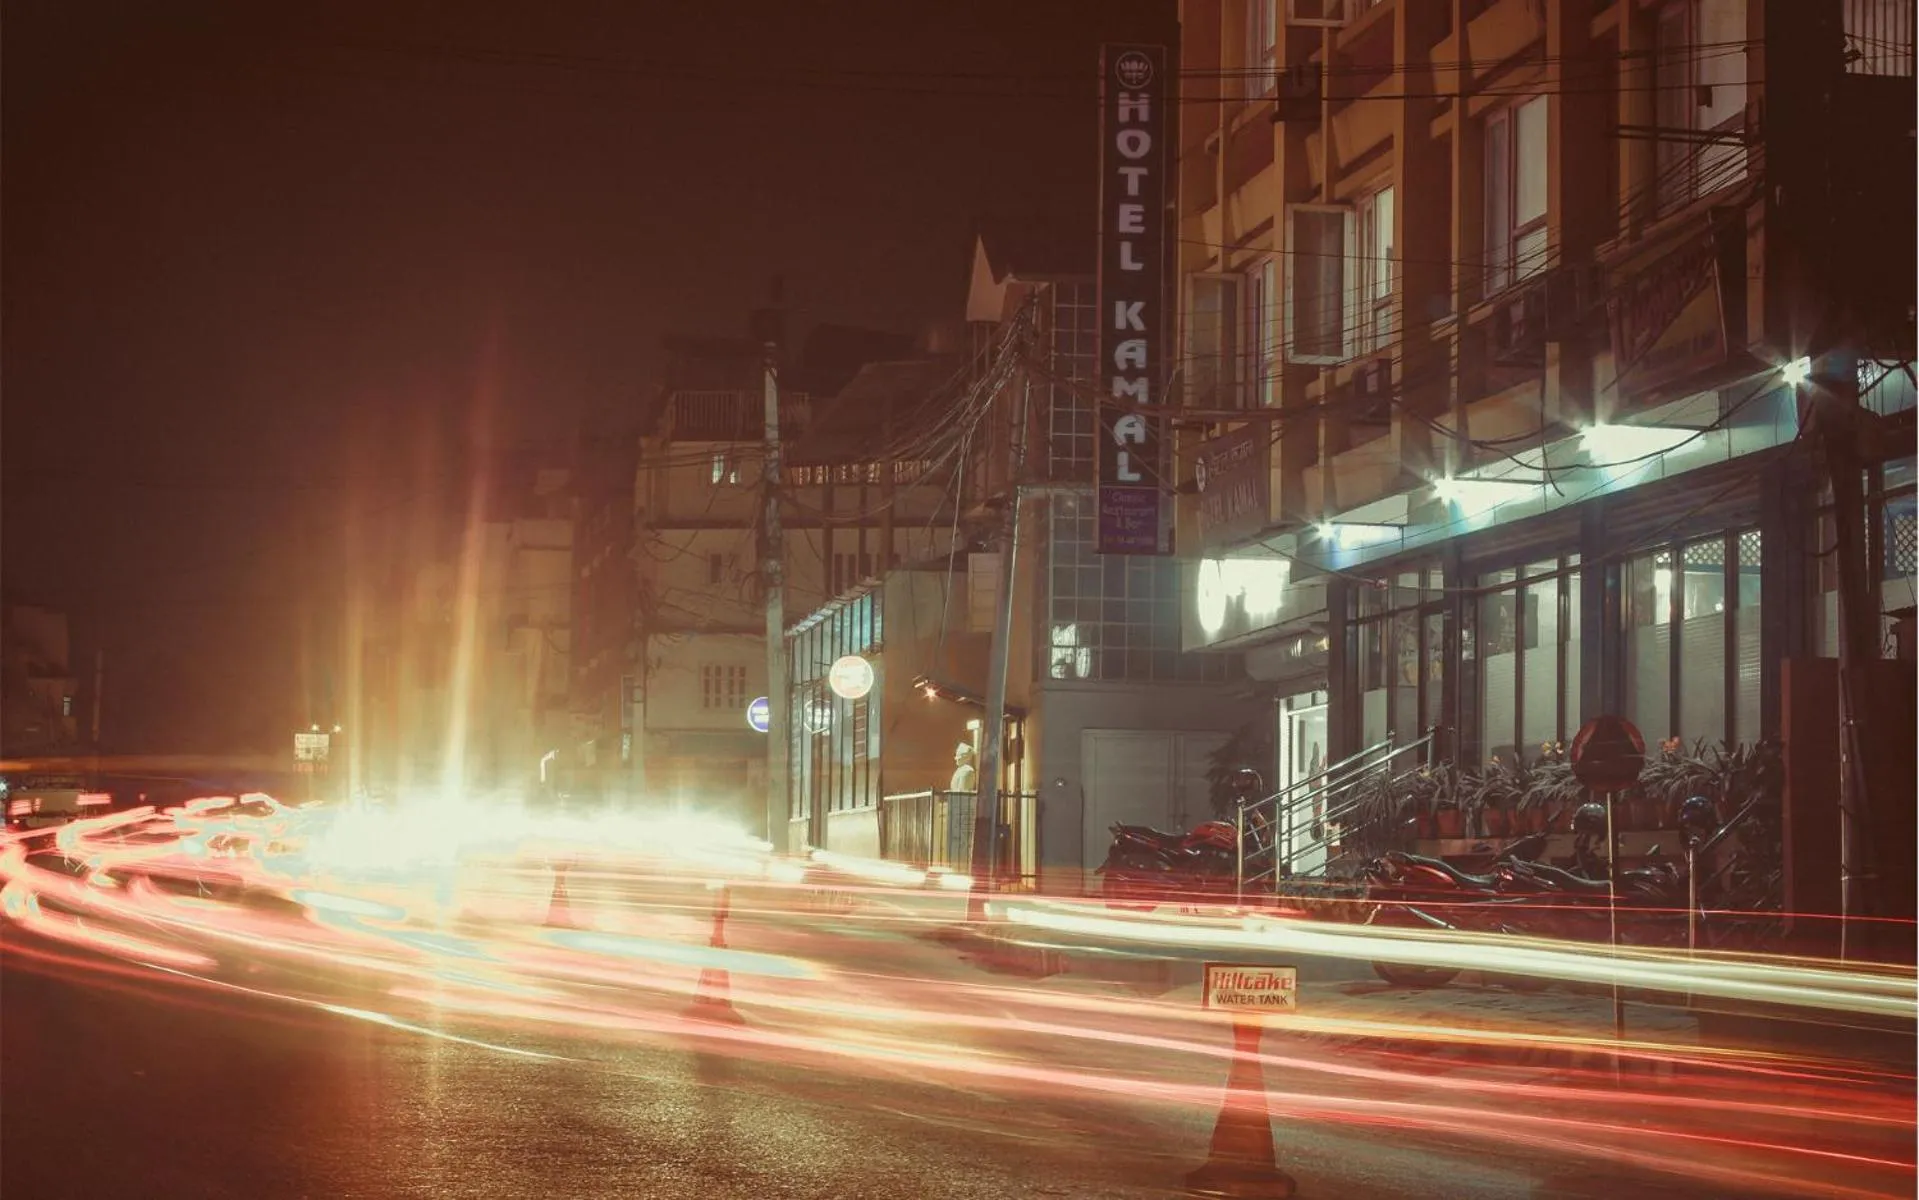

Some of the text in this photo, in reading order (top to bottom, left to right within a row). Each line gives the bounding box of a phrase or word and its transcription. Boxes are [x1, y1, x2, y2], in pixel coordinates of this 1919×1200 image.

[1116, 92, 1151, 271] HOTEL
[1112, 301, 1149, 481] KAMAL
[1216, 994, 1289, 1005] WATER TANK
